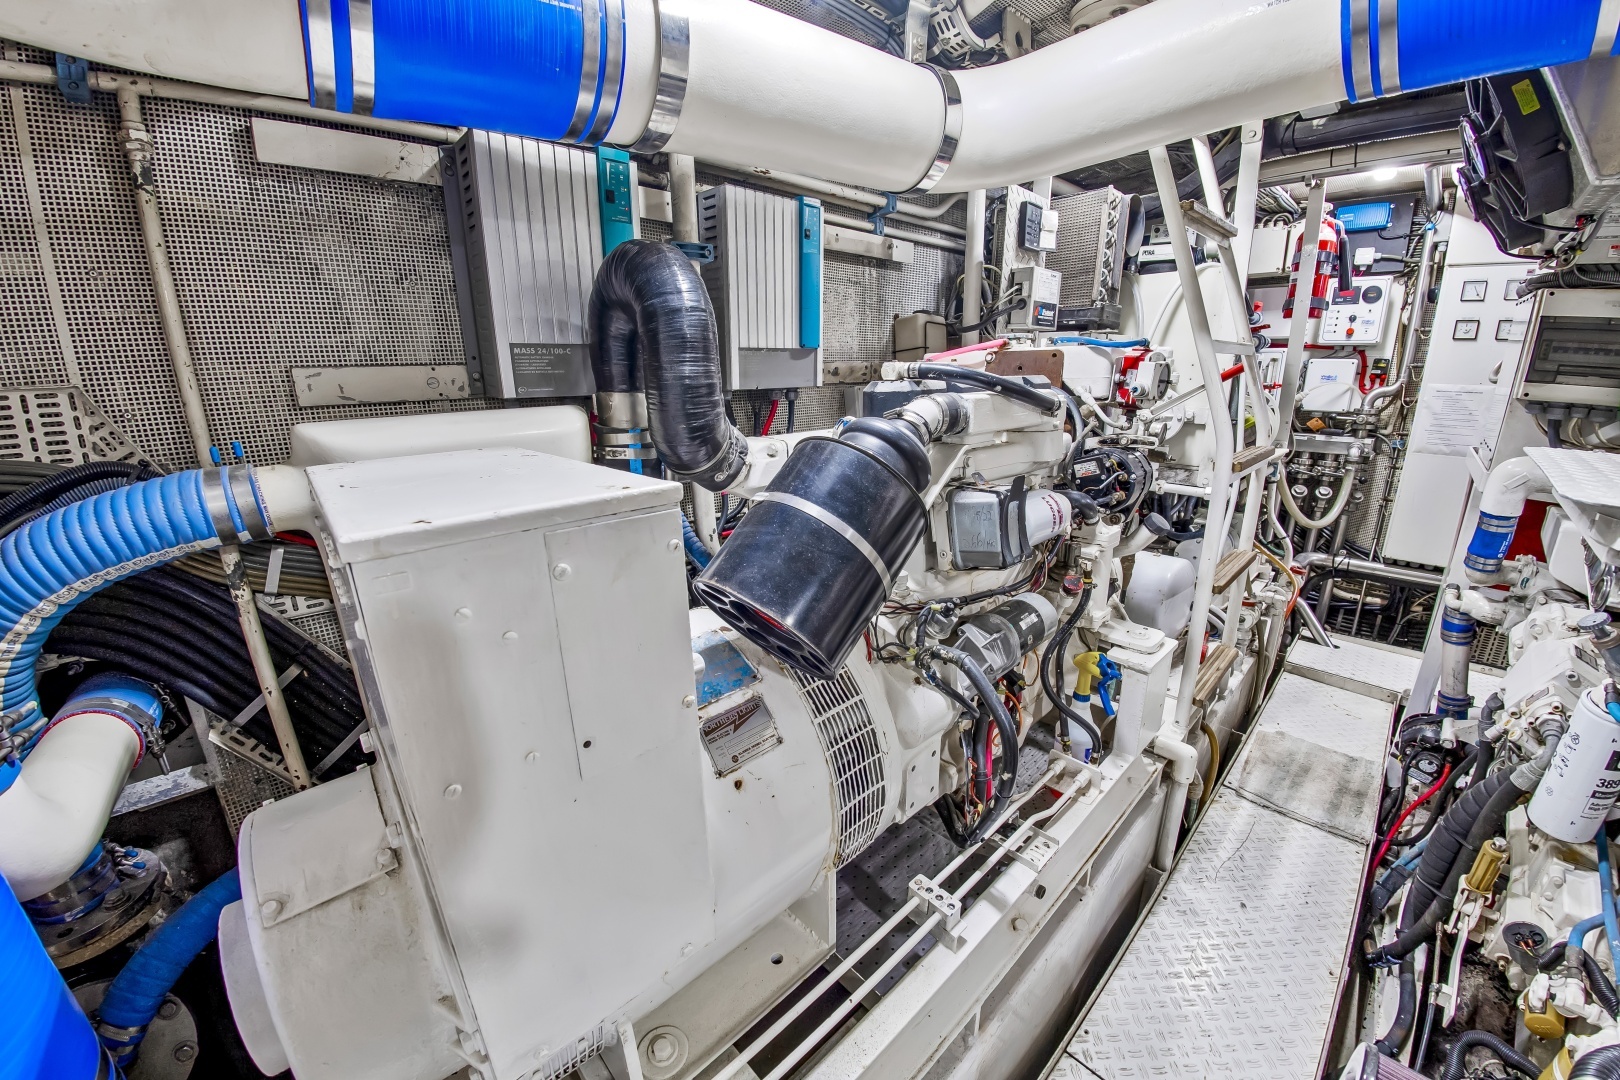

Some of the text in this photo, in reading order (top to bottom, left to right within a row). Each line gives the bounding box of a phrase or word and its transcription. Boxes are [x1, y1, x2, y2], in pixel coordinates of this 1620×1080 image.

[537, 347, 571, 355] 24/100-C
[1041, 496, 1056, 533] LUGGER
[1, 632, 23, 658] TRIDEN
[22, 613, 38, 631] #25
